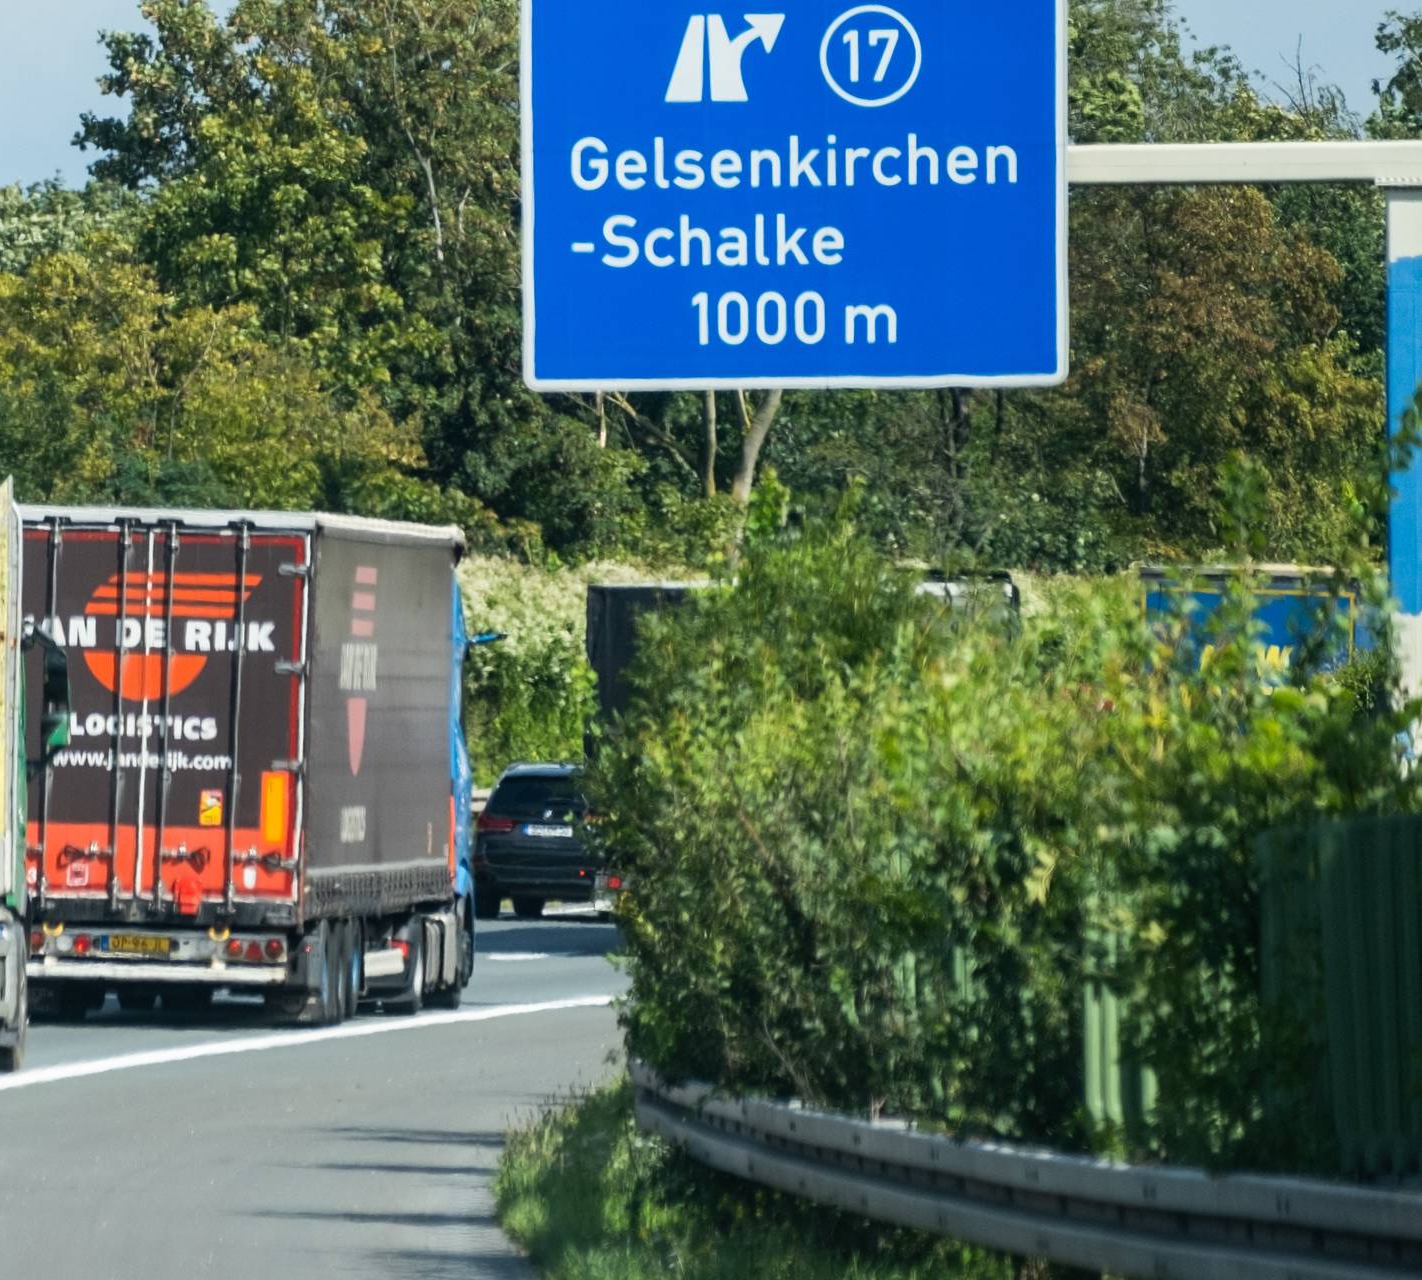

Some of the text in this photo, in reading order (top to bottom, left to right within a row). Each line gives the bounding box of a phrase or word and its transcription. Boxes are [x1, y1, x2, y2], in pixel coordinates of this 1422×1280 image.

[842, 28, 899, 83] 17
[570, 133, 1018, 190] Gelsenkirchen
[571, 213, 845, 268] -Schalke
[691, 290, 898, 346] 1000 m
[115, 617, 167, 649] DE
[69, 712, 218, 741] LOGISTICS
